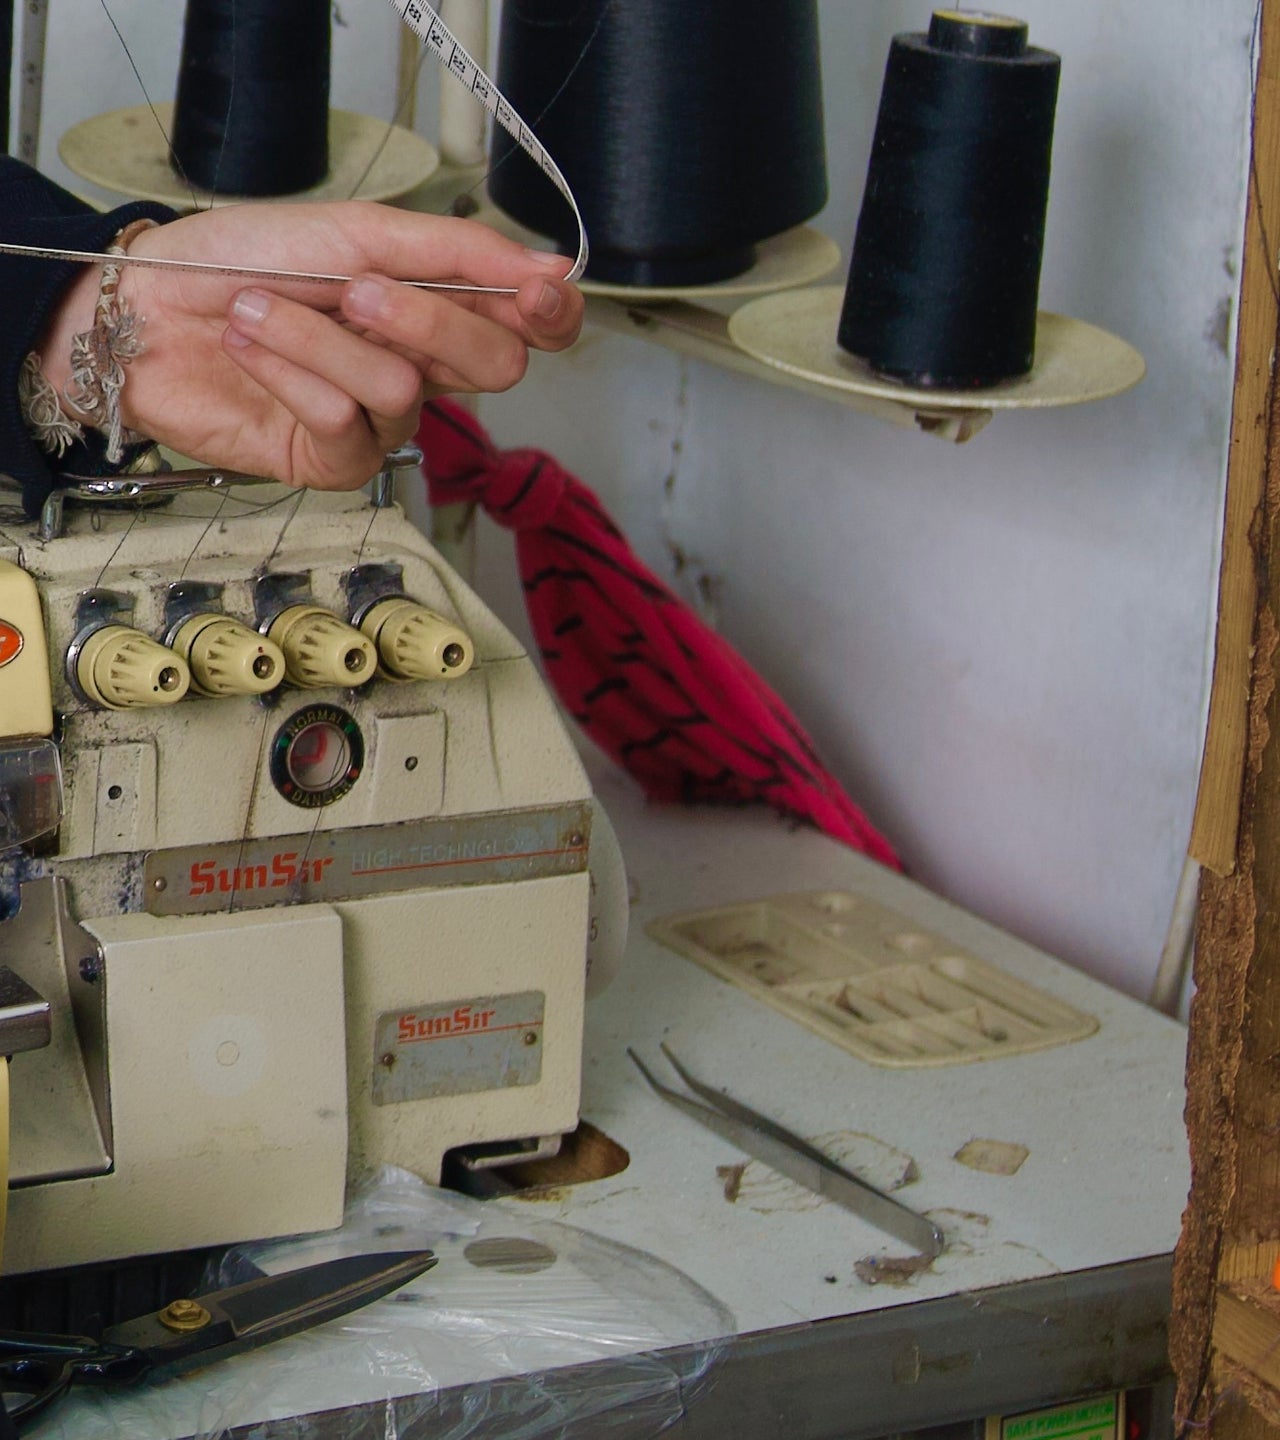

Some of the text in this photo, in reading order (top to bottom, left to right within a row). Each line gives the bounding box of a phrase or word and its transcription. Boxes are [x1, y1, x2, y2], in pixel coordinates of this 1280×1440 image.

[189, 852, 334, 897] SunSir
[398, 1005, 496, 1039] SunSir
[1006, 1420, 1033, 1439] SAVE
